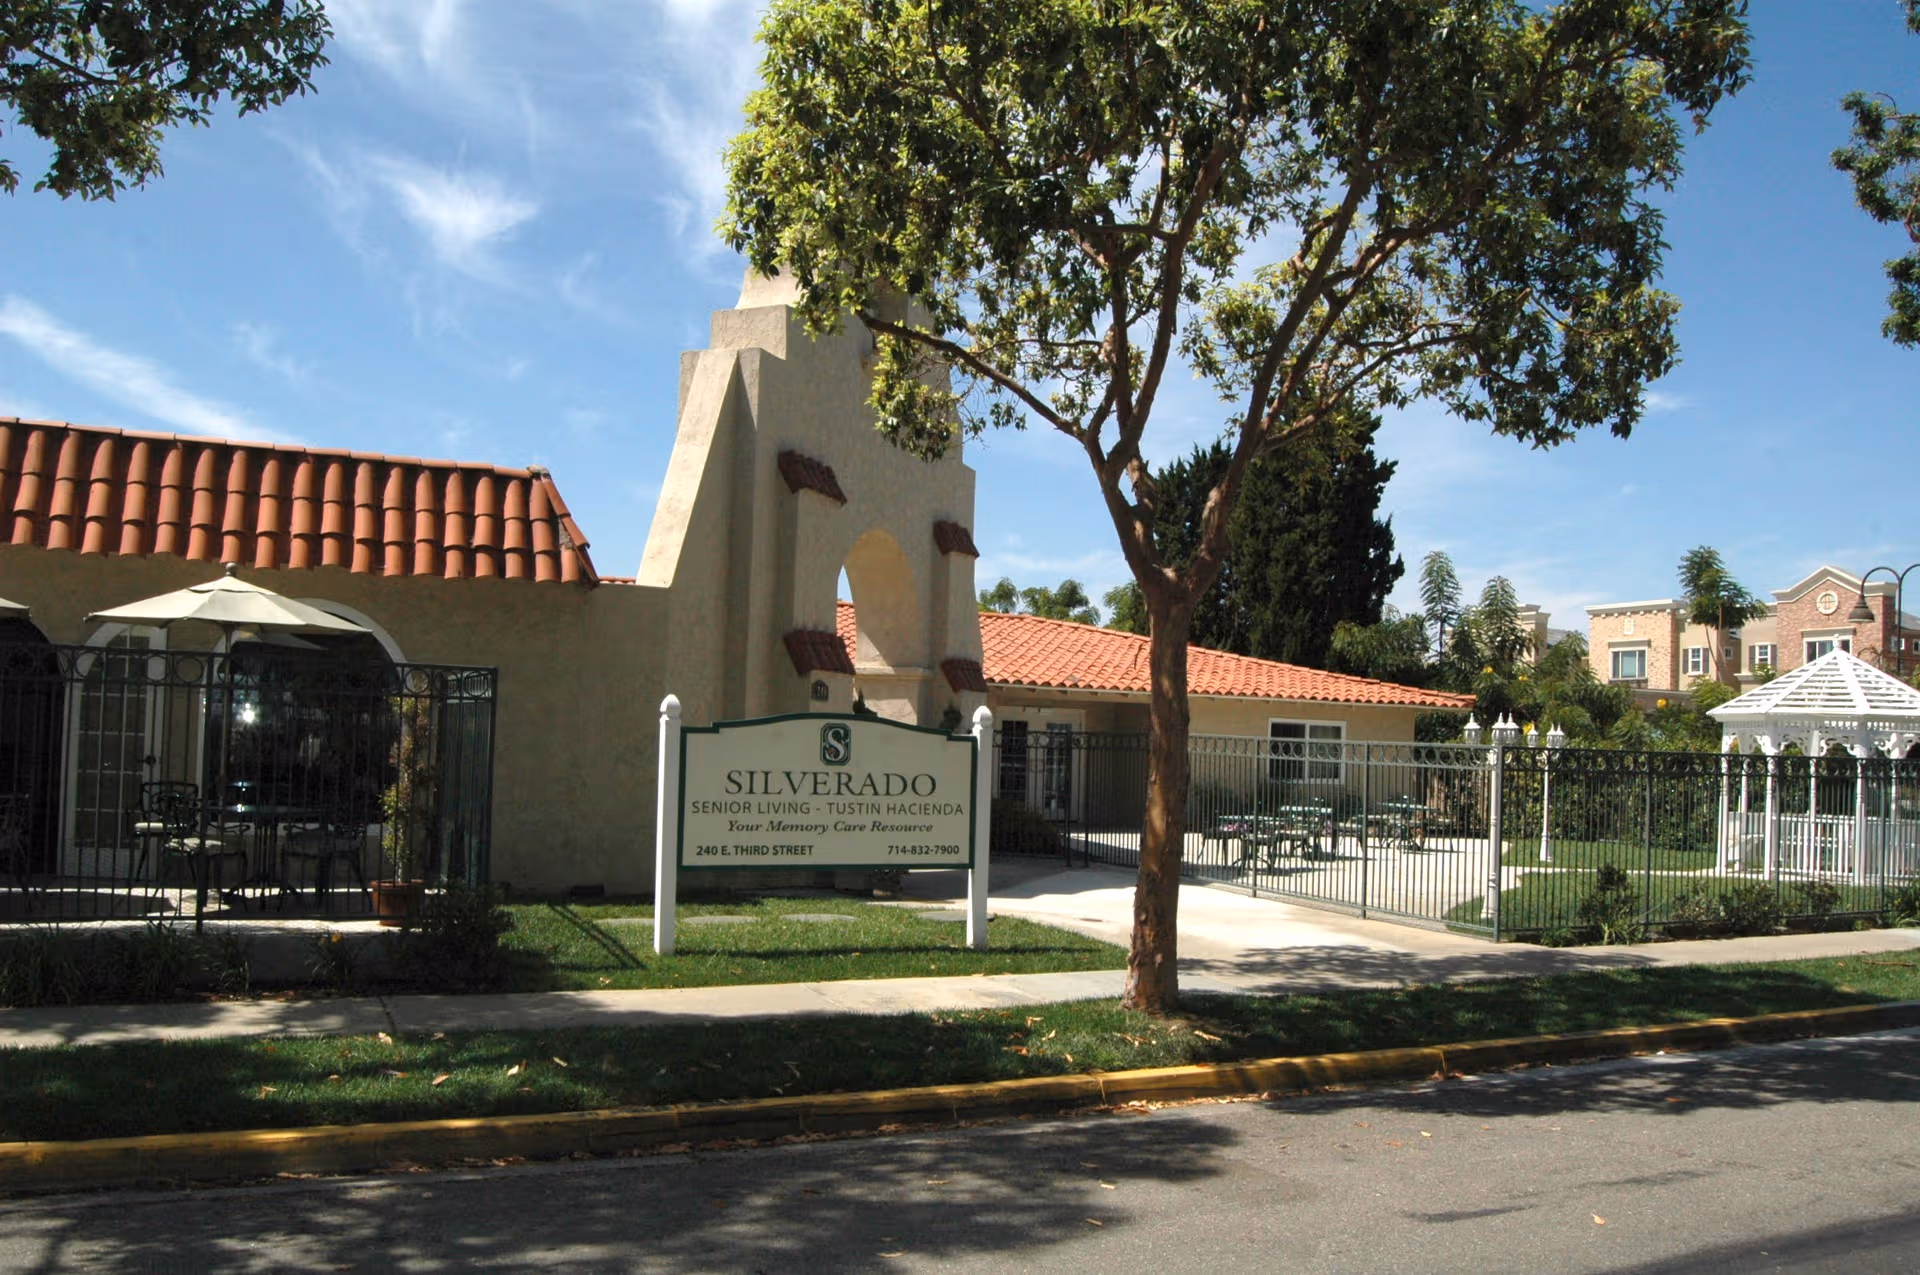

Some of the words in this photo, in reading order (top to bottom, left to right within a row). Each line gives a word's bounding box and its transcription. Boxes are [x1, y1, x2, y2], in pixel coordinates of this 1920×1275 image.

[725, 770, 937, 797] SILVERADO
[691, 801, 752, 815] SENIOR
[758, 801, 811, 815] LIVING
[827, 802, 881, 815] TUSTIN
[886, 803, 964, 816] HACIENDA
[727, 820, 763, 833] Your
[766, 820, 829, 835] Memory
[833, 820, 867, 832] Care
[870, 820, 934, 832] Resource
[696, 845, 718, 856] 240
[721, 845, 731, 856] E.
[733, 845, 770, 856] THIRD
[772, 845, 814, 856] STREET
[887, 845, 960, 855] 714-832-7900
